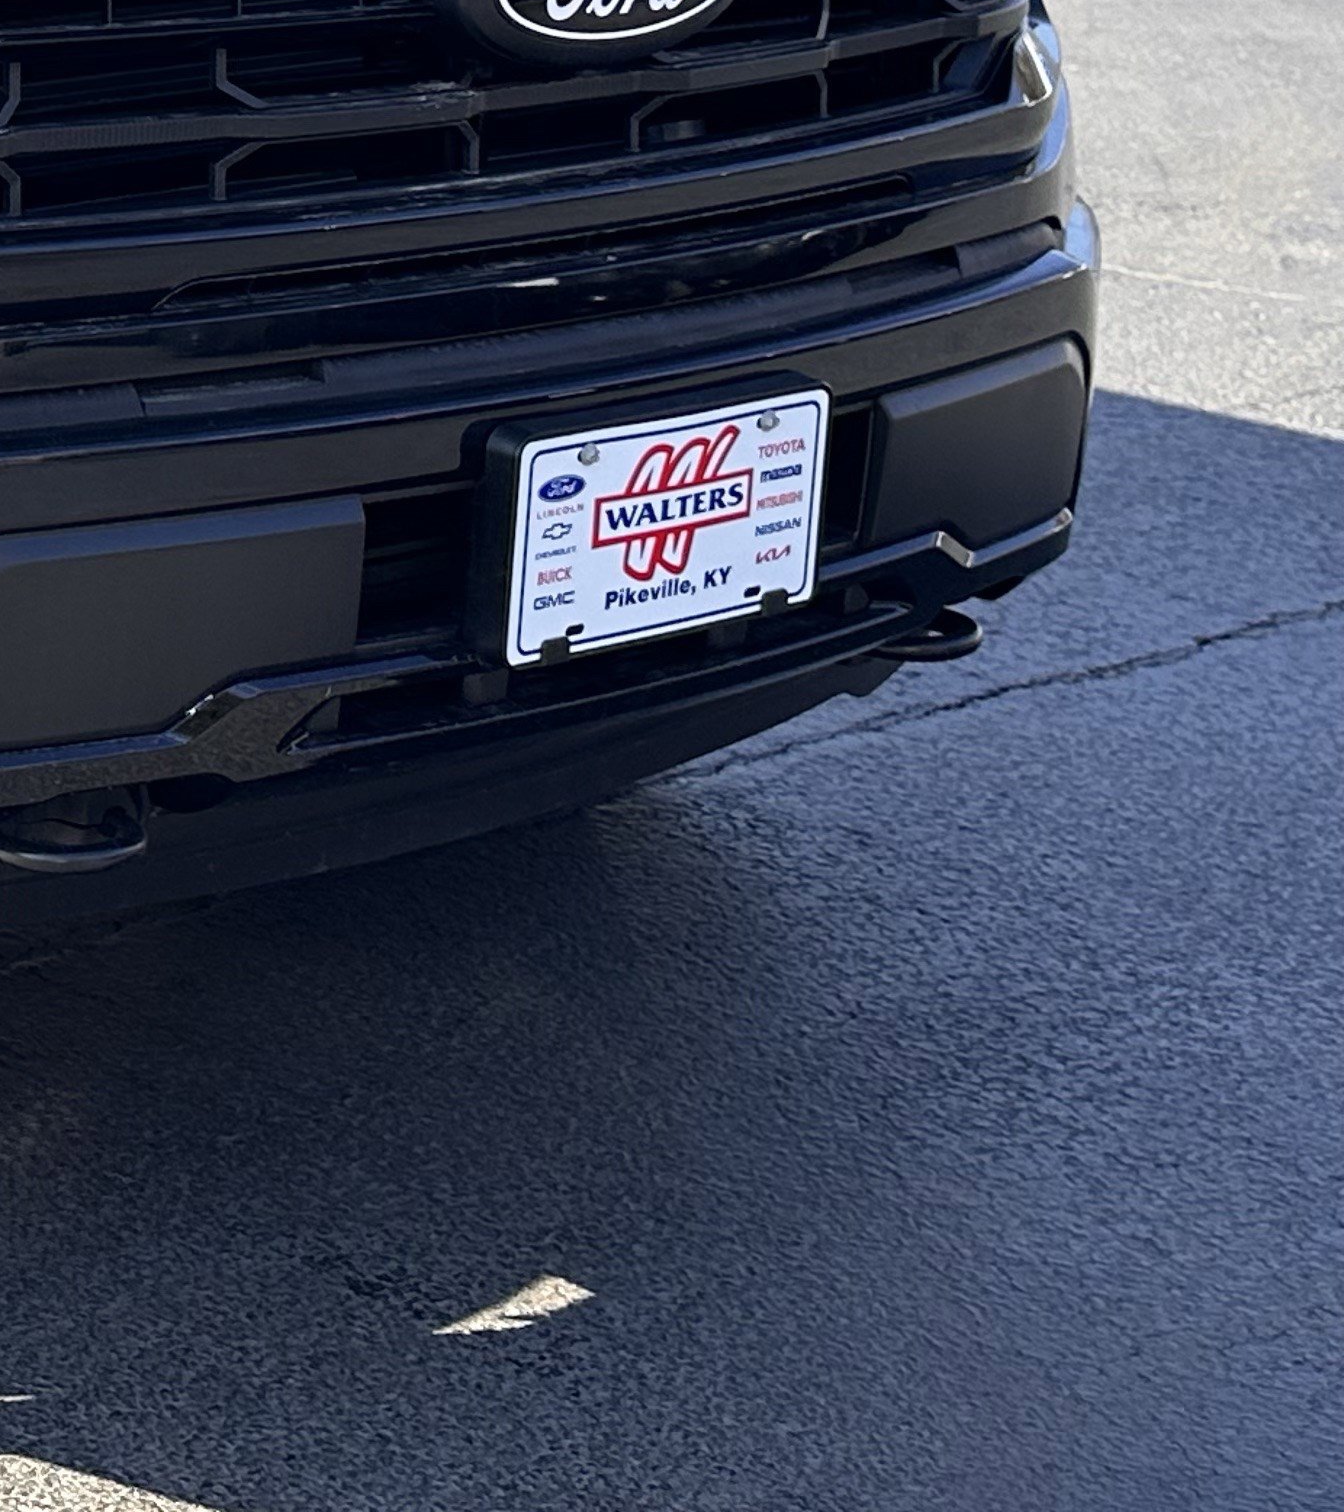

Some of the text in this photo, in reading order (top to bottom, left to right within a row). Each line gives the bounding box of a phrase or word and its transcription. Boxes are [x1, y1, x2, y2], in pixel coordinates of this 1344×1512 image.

[758, 438, 806, 459] TOYOTA
[536, 503, 584, 520] LINCOLN
[605, 482, 744, 531] WALTERS
[755, 516, 801, 537] NISSAN
[537, 566, 573, 586] BUICK
[604, 566, 733, 610] Pikeville, KY
[533, 590, 576, 611] GMC
